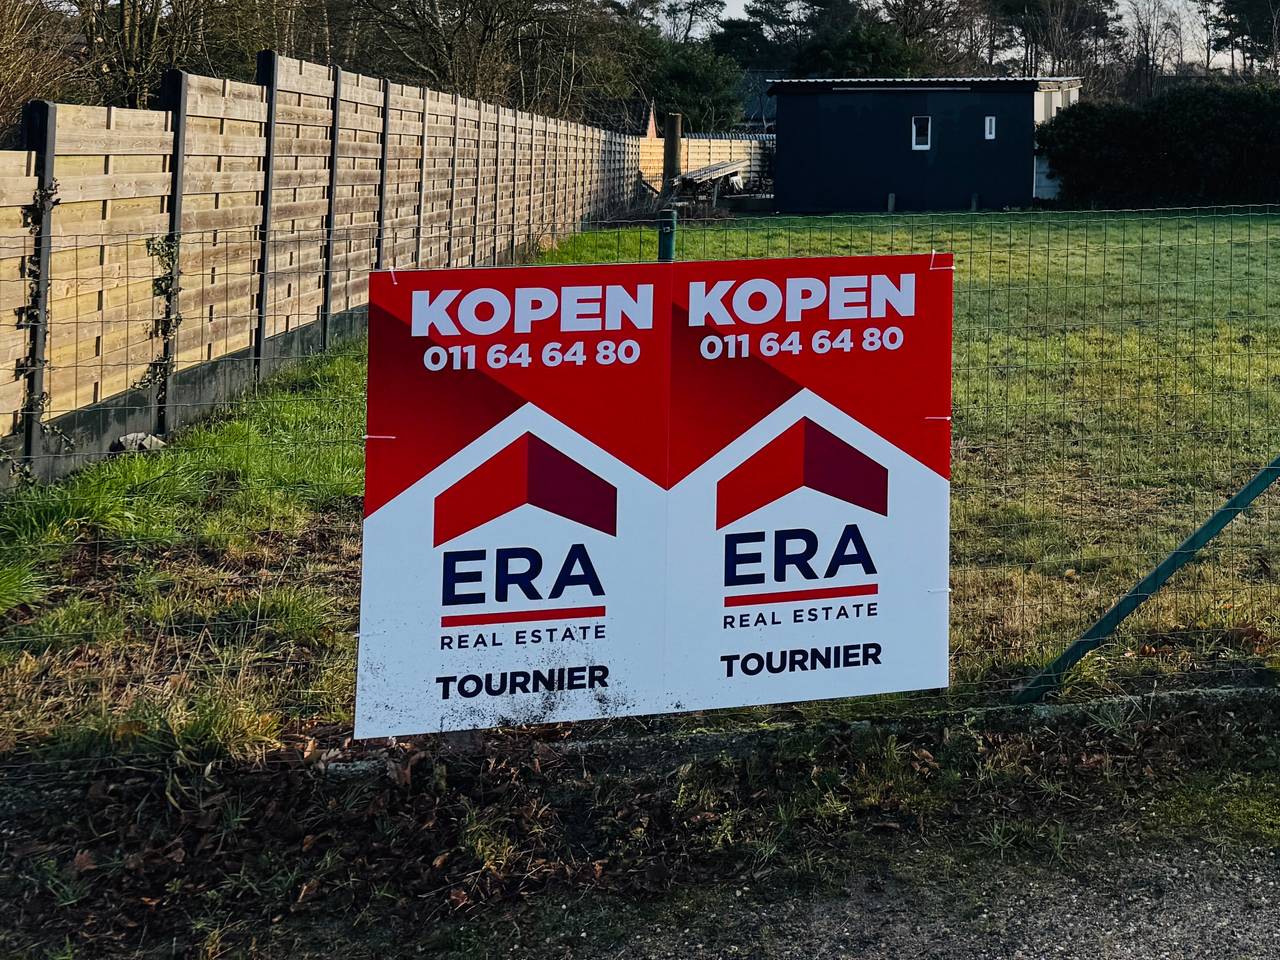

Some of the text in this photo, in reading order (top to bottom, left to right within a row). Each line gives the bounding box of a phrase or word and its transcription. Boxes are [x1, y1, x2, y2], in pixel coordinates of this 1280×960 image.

[411, 284, 654, 337] KOPEN
[689, 274, 916, 327] KOPEN
[423, 340, 641, 371] 011 64 64 80
[700, 327, 904, 360] 011 64 64 80
[723, 524, 878, 588] ERA
[441, 543, 606, 607] ERA
[723, 602, 878, 630] REAL ESTATE
[440, 624, 606, 651] REAL ESTATE
[719, 642, 883, 678] TOURNIER
[435, 665, 610, 700] TOURNIER
